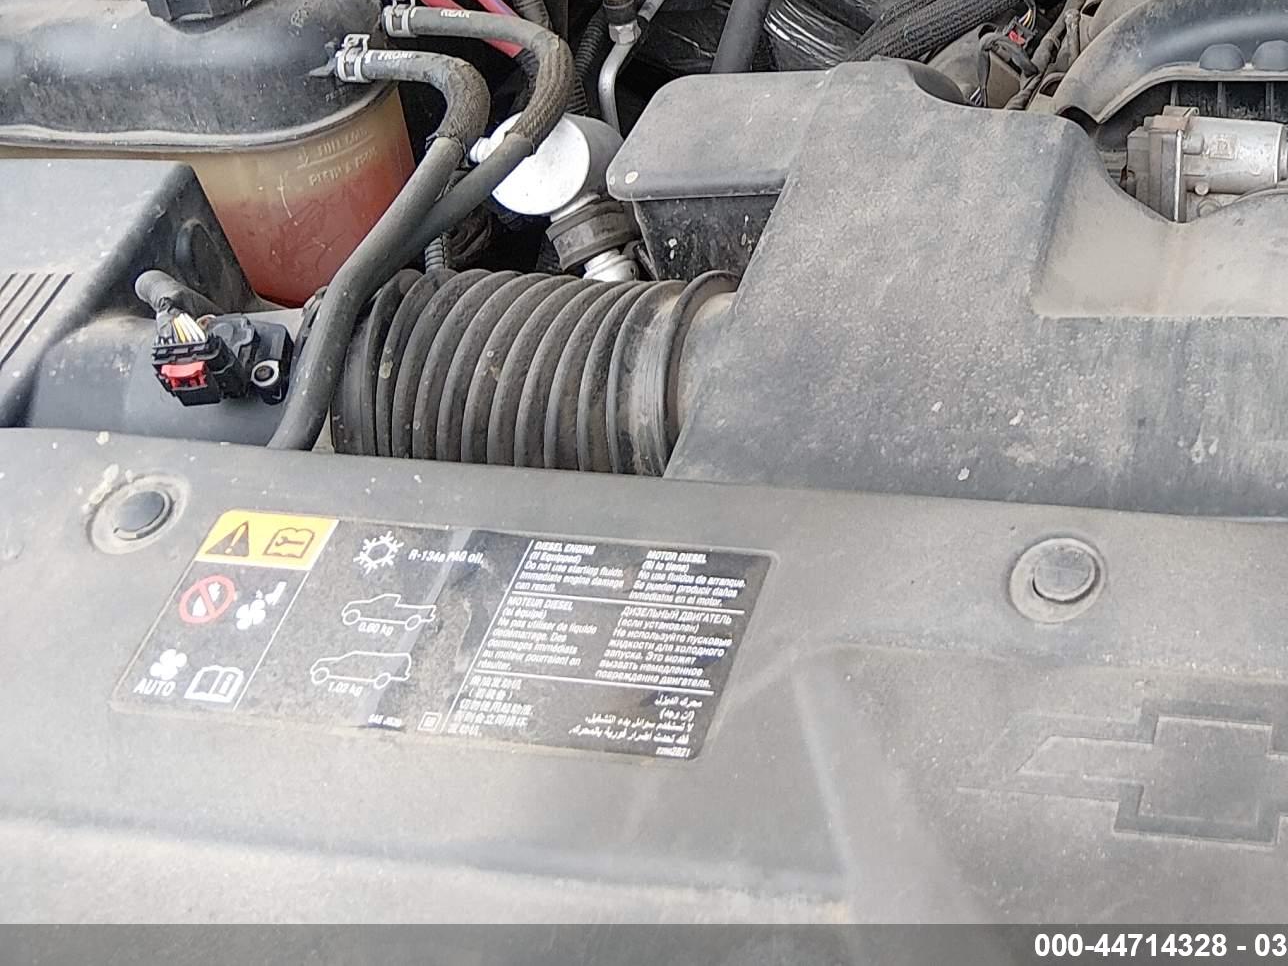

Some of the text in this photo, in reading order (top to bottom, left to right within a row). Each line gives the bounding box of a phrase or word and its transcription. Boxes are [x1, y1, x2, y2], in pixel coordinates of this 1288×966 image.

[377, 52, 414, 61] FRONT
[408, 548, 446, 562] R-134a
[534, 541, 596, 555] DIESEL ENGINE
[647, 550, 707, 563] MOTOR DIESEL
[524, 561, 623, 577] Do not use starting fluids.
[563, 575, 590, 585] engine
[591, 577, 624, 588] damage
[638, 570, 746, 588] No use fluidos de arranque.
[515, 581, 556, 592] can result.
[633, 580, 738, 597] Se pueden producir daños
[507, 596, 573, 611] MOTEUR DIESEL
[675, 595, 686, 603] en
[687, 595, 696, 604] el
[696, 596, 722, 606] motor.
[621, 607, 732, 625] ДИЗЕЛЬНЫЙ ДВИГАТЕЛЬ
[380, 625, 394, 637] kg
[498, 618, 509, 626] Ne
[557, 623, 568, 631] de
[618, 618, 700, 634] (если установлен)
[613, 628, 626, 637] Не
[687, 635, 733, 647] пусковые
[608, 639, 725, 657] жидкости для холодного
[645, 652, 663, 662] Это
[133, 678, 176, 697] AUTO
[349, 683, 364, 697] kg
